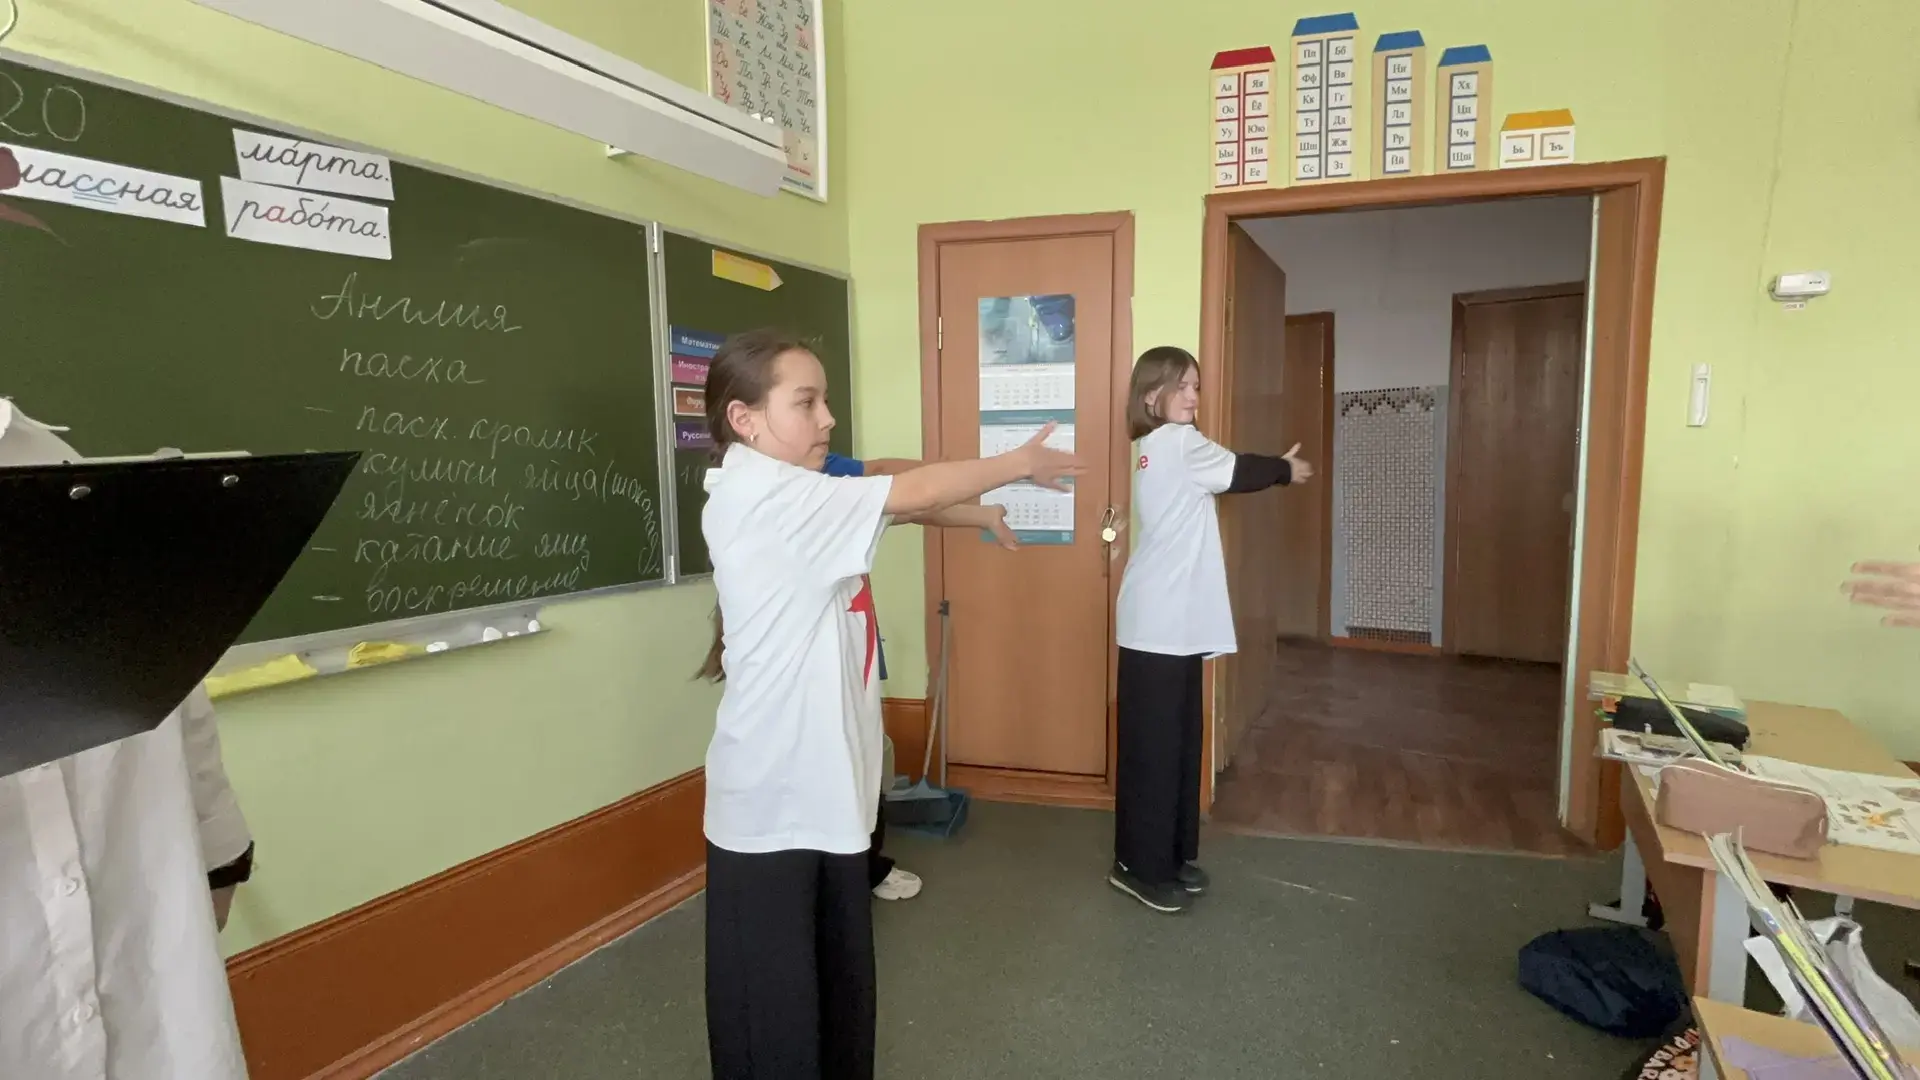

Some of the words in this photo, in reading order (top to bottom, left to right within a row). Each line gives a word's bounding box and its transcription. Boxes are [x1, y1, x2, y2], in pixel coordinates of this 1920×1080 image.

[1304, 48, 1316, 58] Пп
[1335, 46, 1346, 55] Бб
[1302, 73, 1317, 84] Фф
[1334, 69, 1345, 79] Вв
[1221, 83, 1232, 92] Аа
[1252, 79, 1264, 88] Яя
[1457, 81, 1471, 90] Хх
[1391, 86, 1408, 95] Мм
[1303, 95, 1315, 104] Кк
[1334, 93, 1345, 102] Гг
[1222, 106, 1234, 114] Оо
[1392, 109, 1404, 119] Лл
[1457, 105, 1471, 115] Цц
[1304, 118, 1314, 127] Тт
[1333, 116, 1346, 126] Дд
[1221, 128, 1233, 139] Уу
[1248, 125, 1265, 134] Юю
[1456, 128, 1469, 138] Чч
[1331, 138, 1348, 147] Жж
[1393, 133, 1404, 144] Рр
[1300, 142, 1317, 151] Шш
[1512, 145, 1525, 154] Ьь
[1550, 142, 1563, 151] Ъъ
[1218, 149, 1234, 159] Ыы
[1391, 155, 1404, 166] Йй
[1303, 164, 1314, 173] Сс
[1334, 161, 1344, 170] Зз
[1250, 168, 1260, 177] Ее
[20, 164, 200, 211] лассная
[310, 272, 522, 332] Англия
[340, 349, 486, 384] пасха
[678, 360, 710, 372] Иностра
[469, 418, 599, 459] кролик
